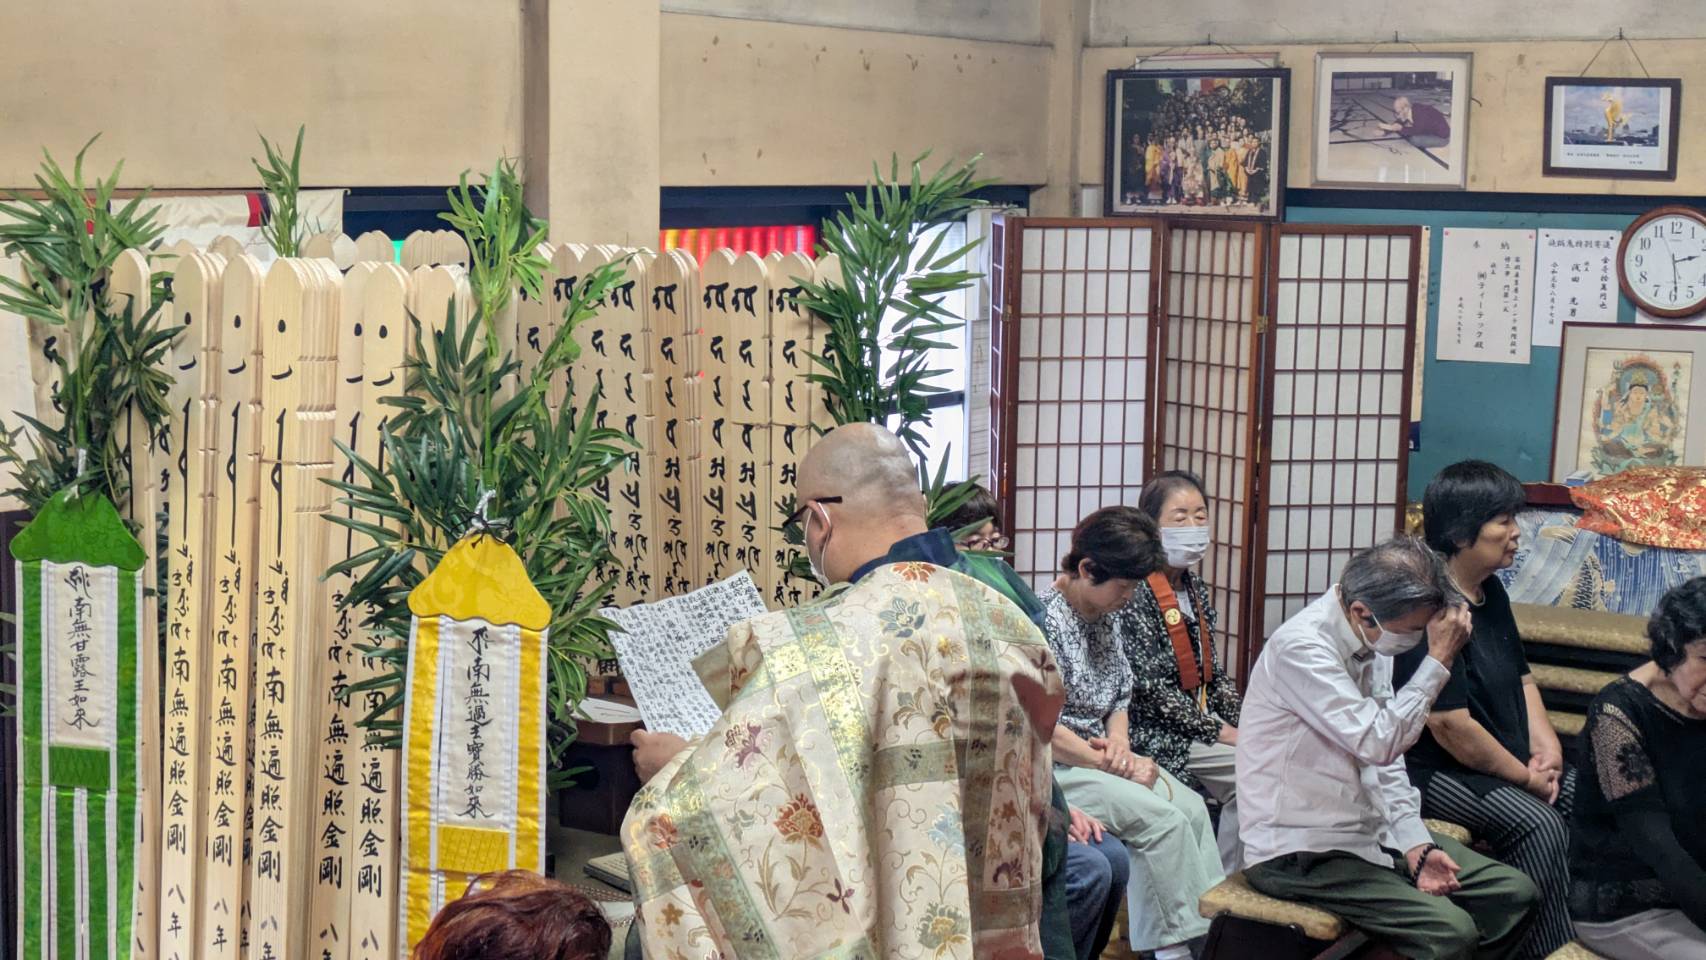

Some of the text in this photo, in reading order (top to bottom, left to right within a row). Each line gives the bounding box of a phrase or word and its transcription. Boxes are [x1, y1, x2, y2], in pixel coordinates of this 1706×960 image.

[1654, 225, 1664, 238] 11
[1671, 221, 1683, 235] 12
[1691, 226, 1695, 239] 1
[1639, 237, 1652, 250] 10
[1635, 255, 1643, 267] 9
[1639, 271, 1648, 283] 8
[1698, 273, 1706, 287] 4
[1653, 284, 1662, 297] 7
[1669, 290, 1677, 302] 6
[1686, 285, 1695, 298] 5
